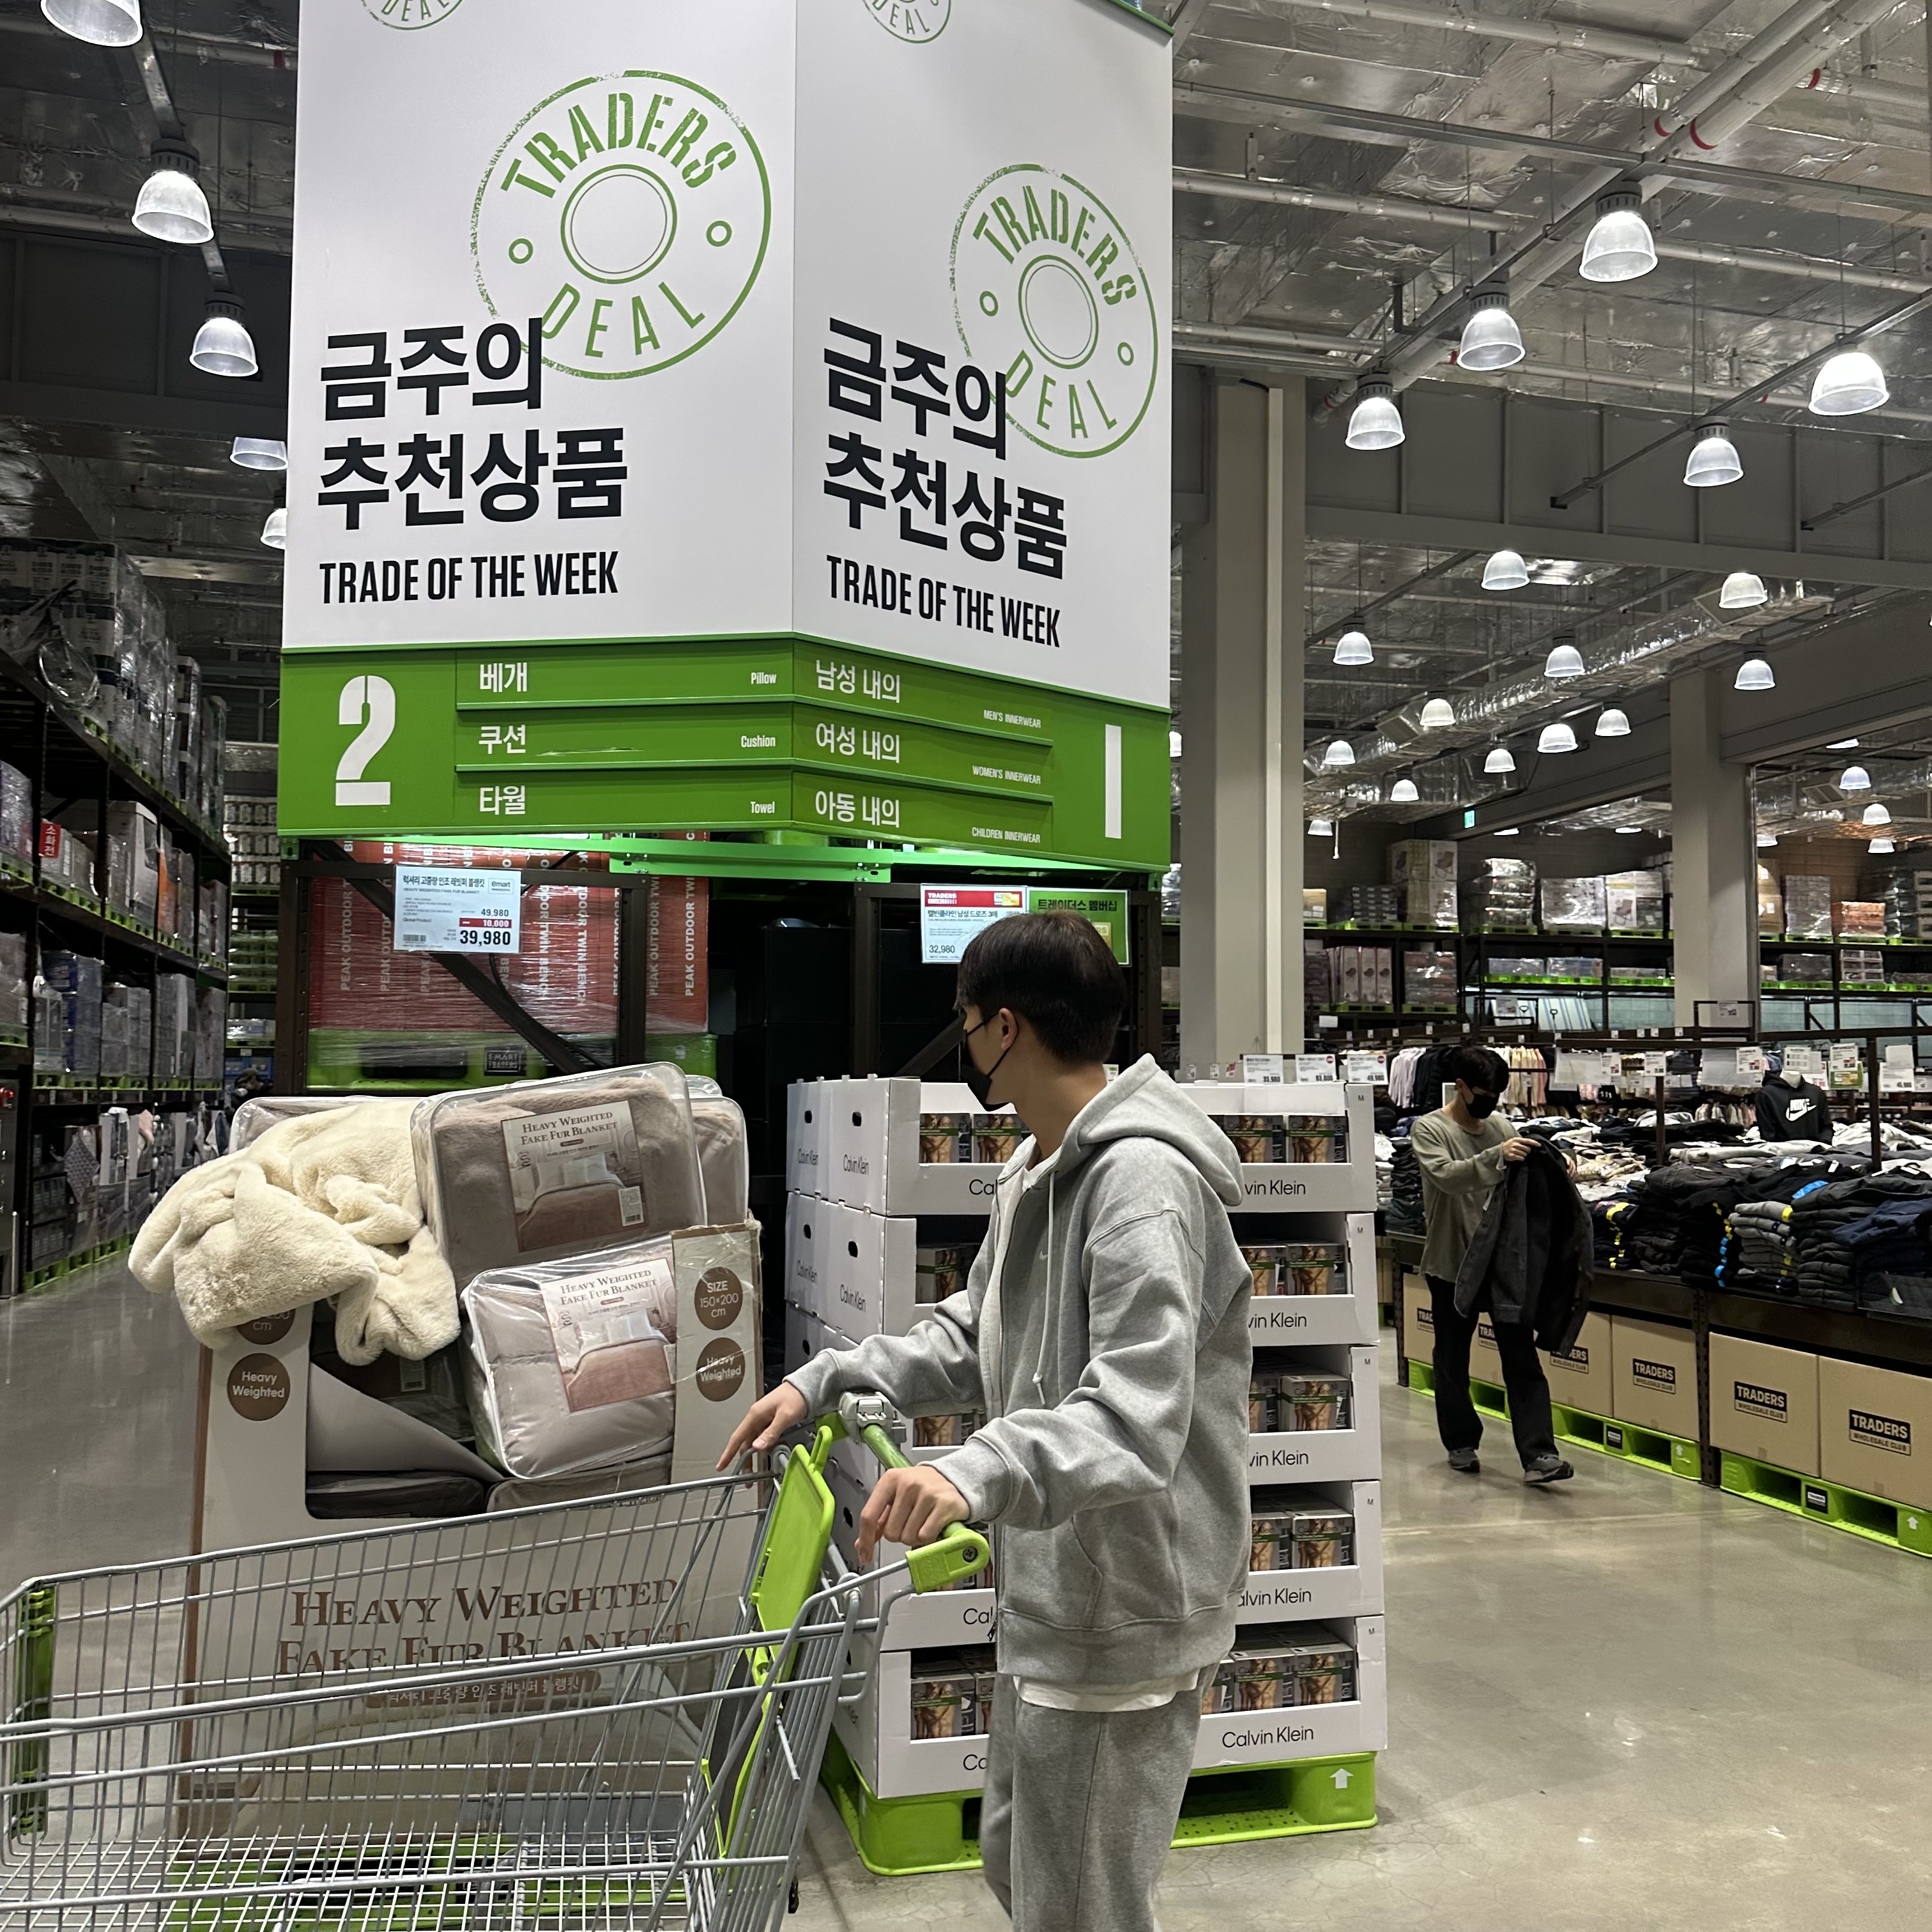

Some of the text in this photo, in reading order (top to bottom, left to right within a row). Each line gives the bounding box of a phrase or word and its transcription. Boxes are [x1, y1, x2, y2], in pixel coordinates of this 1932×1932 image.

[500, 93, 737, 198] TRADERS
[972, 185, 1137, 306] TRADERS
[542, 282, 705, 357] DEAL
[321, 317, 542, 421] 금주의
[824, 317, 1006, 461] 금주의
[1005, 350, 1117, 439] DEAL
[318, 427, 628, 530] 추천상품
[824, 431, 1067, 579] 추천상품
[319, 551, 618, 604] TRADE OF THE WEEK
[827, 554, 1061, 647] TRADE OF THE WEEK
[479, 662, 528, 693] 베개
[750, 672, 777, 686] Pillow
[815, 660, 900, 703] 남성 내의
[983, 710, 1041, 729] MEN'S INNERWEAR
[335, 675, 396, 806] 2
[479, 724, 526, 755] 쿠션
[740, 734, 776, 748] Cushion
[815, 723, 900, 763] 여성 내의
[972, 765, 1041, 785] WOMEN'S INNERWEAR
[1105, 723, 1122, 839] 1
[479, 786, 526, 815] 타월
[750, 801, 776, 815] Towel
[815, 790, 900, 828] 아동 내의
[972, 827, 1041, 844] CHILDREN INNERWEAR
[403, 875, 420, 885] 럭셔리
[439, 877, 450, 885] 인조
[481, 908, 509, 917] 49,980
[1038, 899, 1117, 911] 트레이더스 멤버십
[342, 891, 352, 953] OUTDOOR
[650, 901, 659, 960] OUTDOOR
[685, 902, 694, 961] OUTDOOR
[459, 930, 511, 947] 39,980
[577, 930, 587, 961] TWIN
[929, 945, 955, 954] 32,980
[341, 957, 351, 990] PEAK
[648, 963, 659, 996] PEAK
[685, 963, 694, 996] PEAK
[1790, 1098, 1810, 1111] NIKE
[521, 1122, 617, 1145] FAKE FUR BLANKET
[522, 1112, 613, 1133] HEAVY WEIGHTED
[843, 1154, 869, 1175] Calvin Klein
[1269, 1179, 1306, 1195] Klein
[560, 1269, 651, 1294] HEAVY WEIGHTED
[560, 1279, 657, 1305] FAKE FUR BLANKET
[707, 1280, 728, 1293] SIZE
[840, 1284, 866, 1312] Calvin Klein
[711, 1307, 726, 1317] cm
[1271, 1312, 1307, 1328] Klein
[252, 1322, 272, 1330] cm
[241, 1371, 277, 1385] Heavy
[700, 1365, 742, 1382] Weighted
[1635, 1362, 1674, 1381] TRADERS
[233, 1385, 285, 1399] Weighted
[1736, 1385, 1784, 1407] TRADERS
[1851, 1414, 1908, 1439] TRADERS
[1272, 1450, 1308, 1466] Klein
[291, 1579, 678, 1626] HEAVY WEIGHTED
[1275, 1588, 1312, 1604] Klein
[276, 1641, 388, 1675] FAKE
[401, 1636, 484, 1665] FUR
[1222, 1726, 1314, 1748] Calvin Klein
